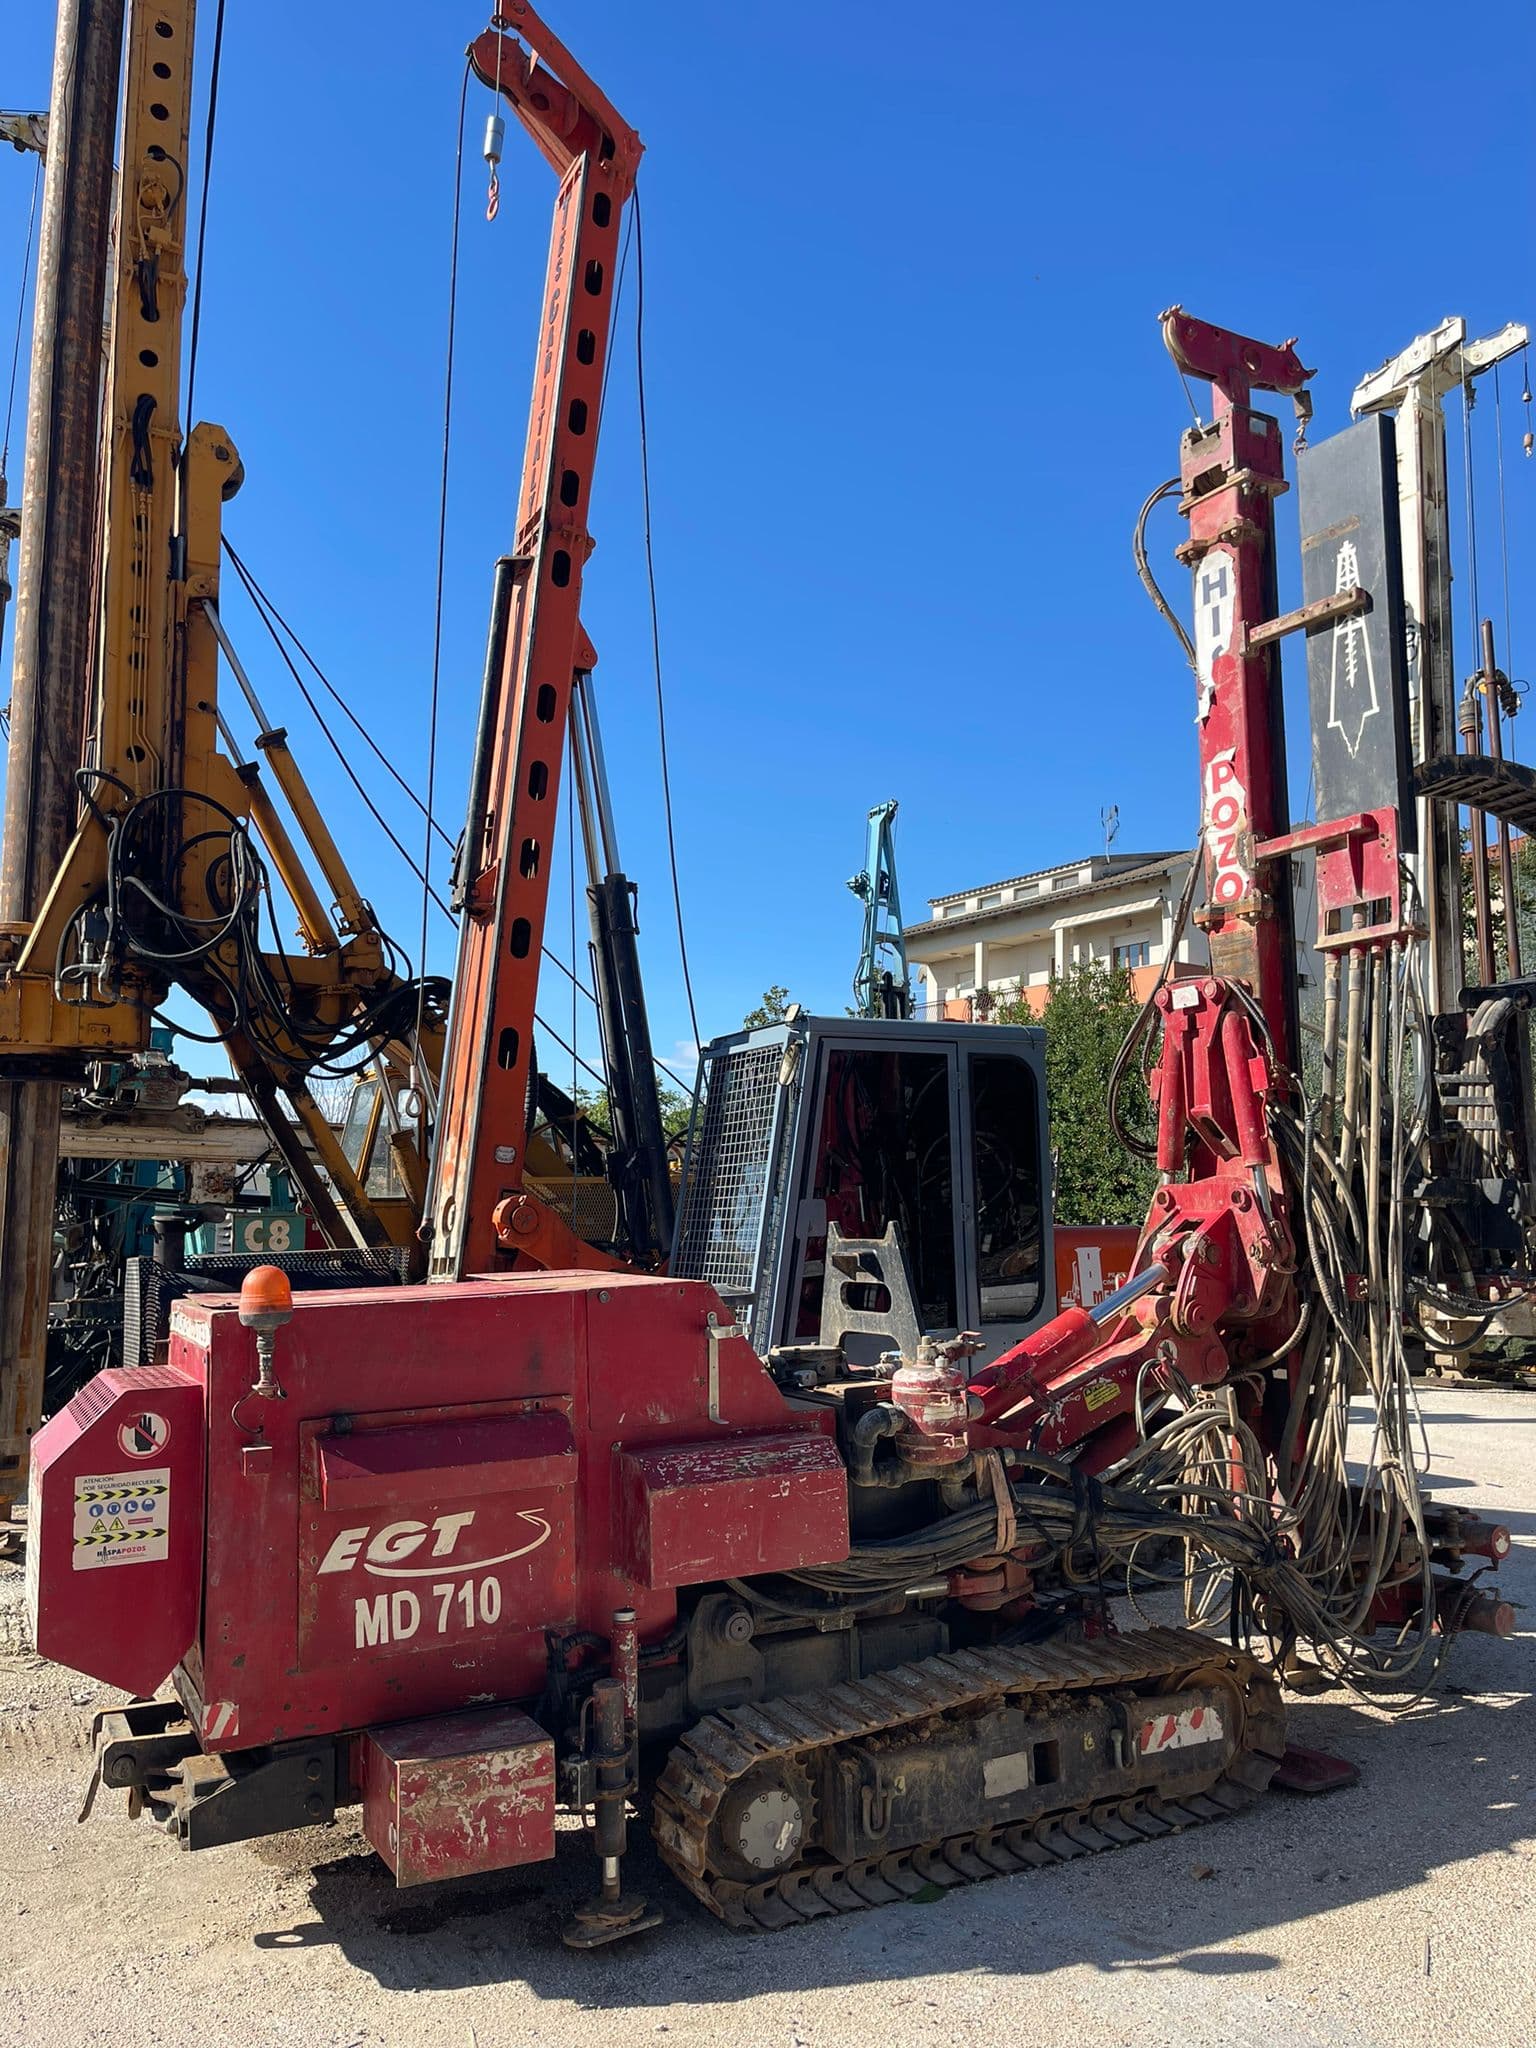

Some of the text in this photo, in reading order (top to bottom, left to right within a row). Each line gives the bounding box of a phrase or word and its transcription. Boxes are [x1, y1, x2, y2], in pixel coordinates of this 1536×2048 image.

[528, 384, 548, 518] ITALY
[244, 1219, 290, 1252] C8
[97, 1482, 131, 1490] SEGURIDAD
[317, 1510, 476, 1575] EGT
[355, 1576, 501, 1649] MD 710
